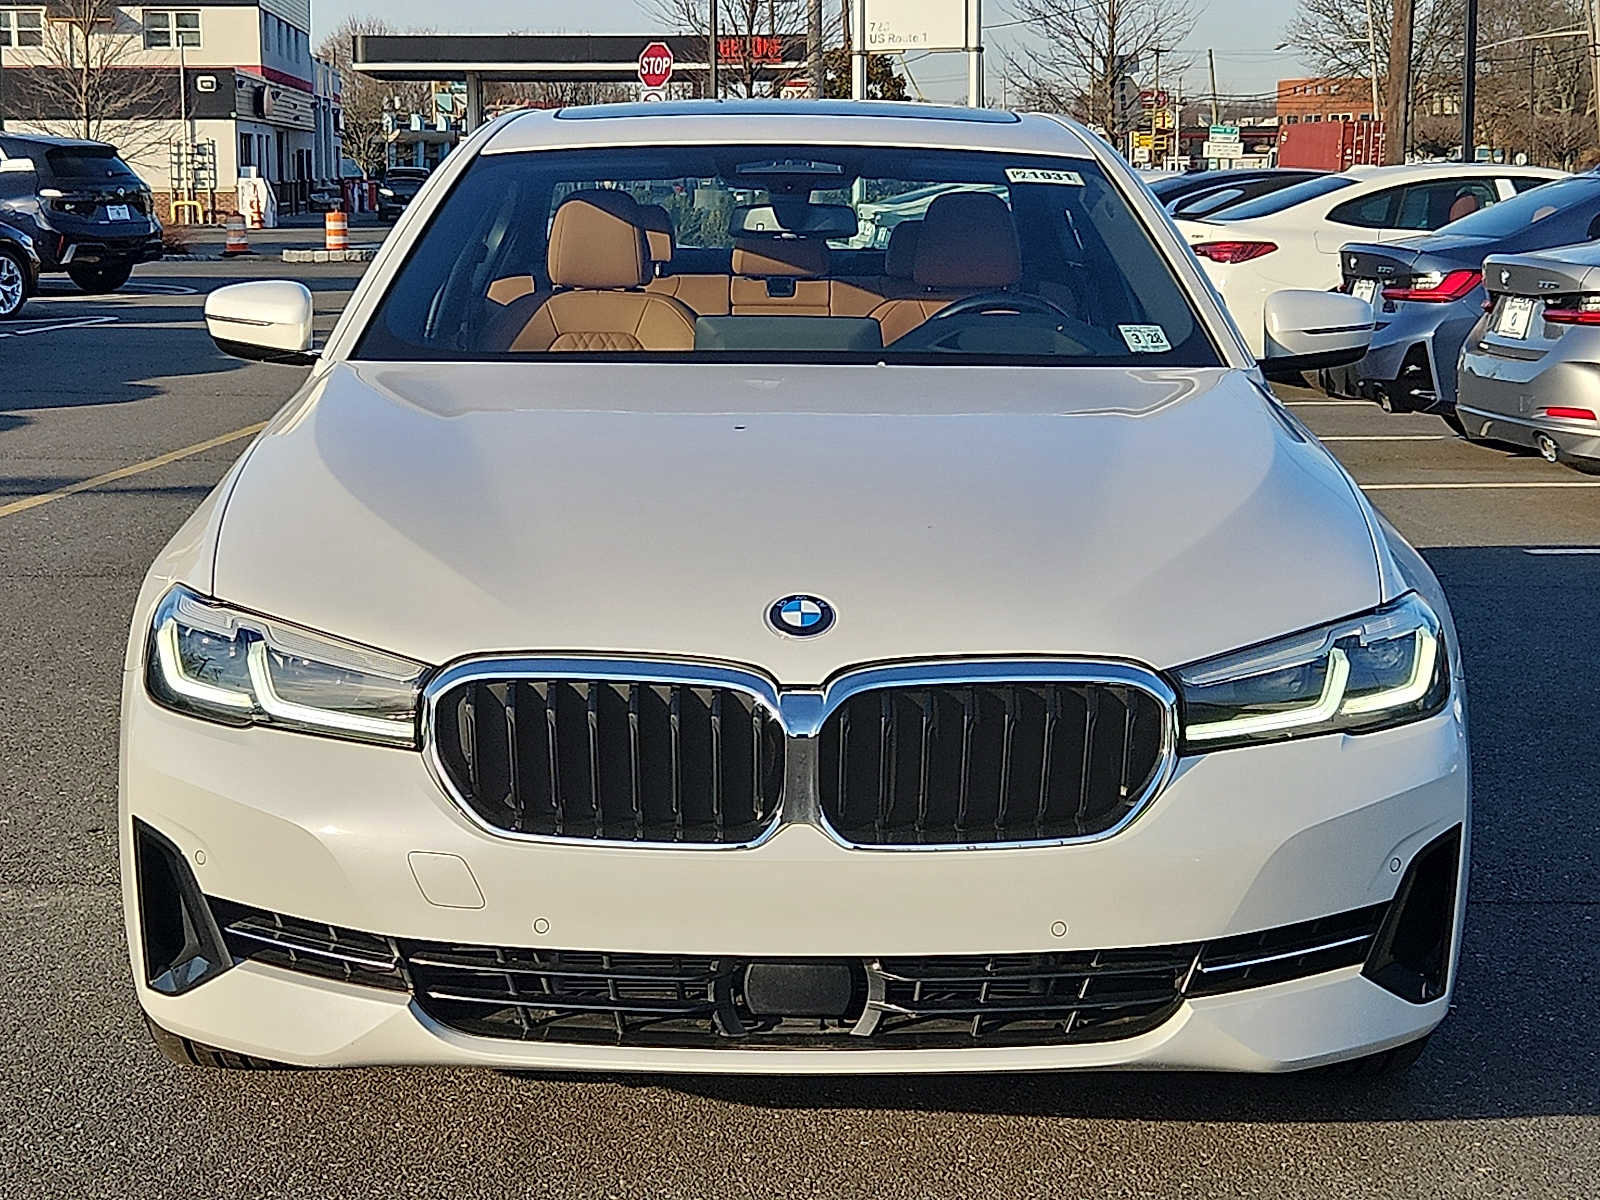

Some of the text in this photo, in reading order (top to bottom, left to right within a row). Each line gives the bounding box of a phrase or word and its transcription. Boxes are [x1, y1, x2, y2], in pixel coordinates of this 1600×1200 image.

[870, 33, 885, 44] US
[641, 56, 670, 75] STOP
[1131, 332, 1164, 344] 3 28
